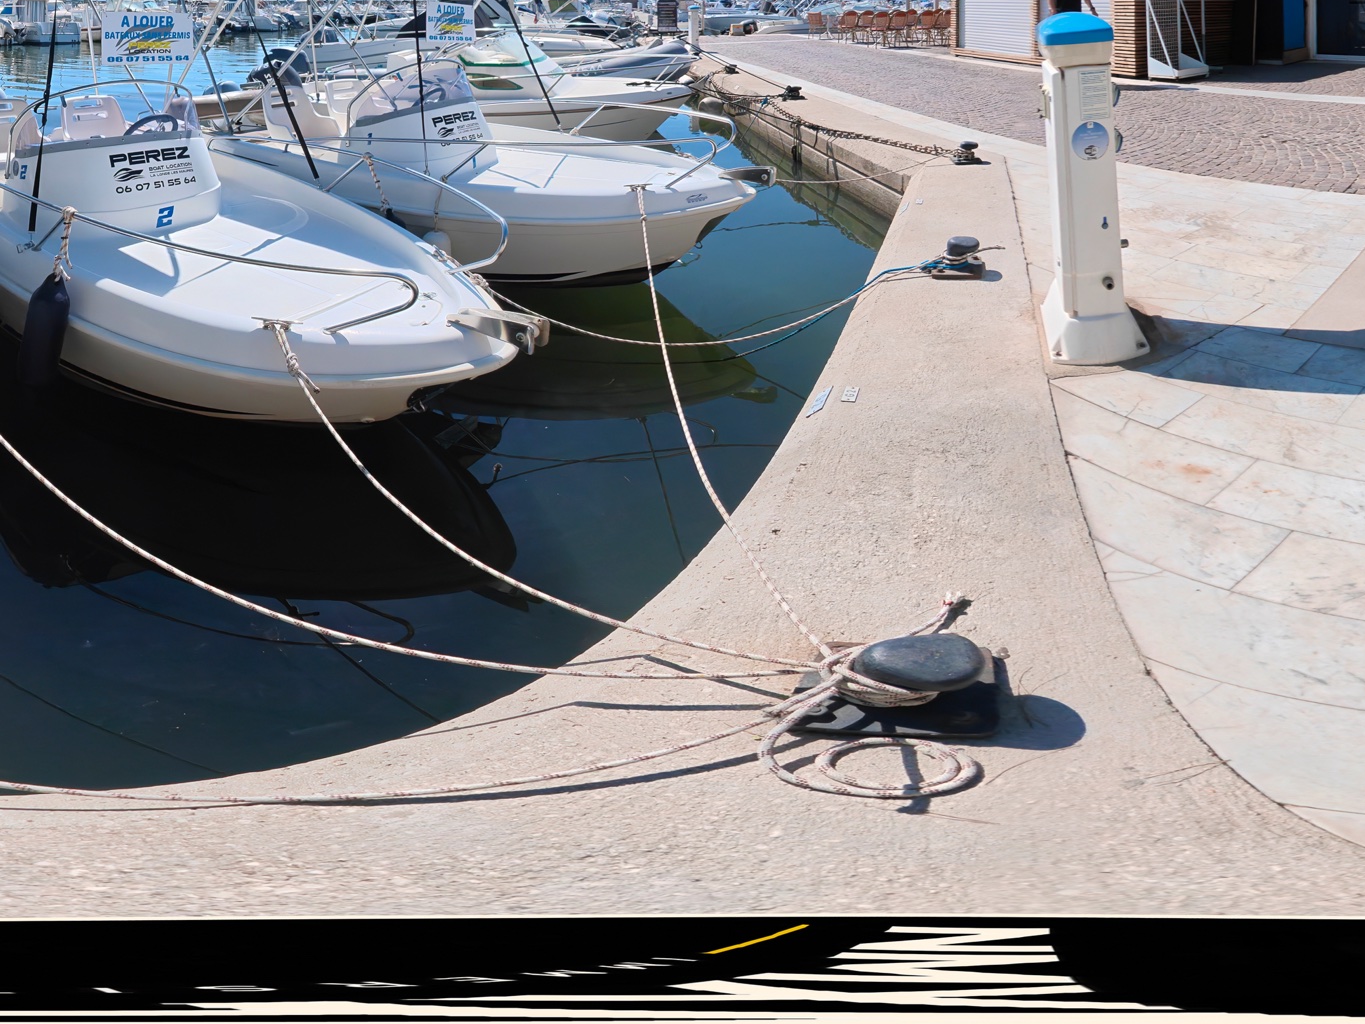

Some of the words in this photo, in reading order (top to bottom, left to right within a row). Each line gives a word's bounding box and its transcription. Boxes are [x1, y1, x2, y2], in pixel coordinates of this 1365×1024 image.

[437, 5, 442, 13] A
[444, 5, 465, 16] LOUER
[121, 16, 130, 27] A
[134, 16, 174, 27] LOUER
[432, 111, 477, 127] PEREZ
[109, 146, 190, 168] PEREZ
[20, 165, 27, 179] 2
[116, 185, 132, 194] 06
[136, 183, 150, 192] 07
[168, 178, 181, 186] 55
[156, 206, 174, 228] 2
